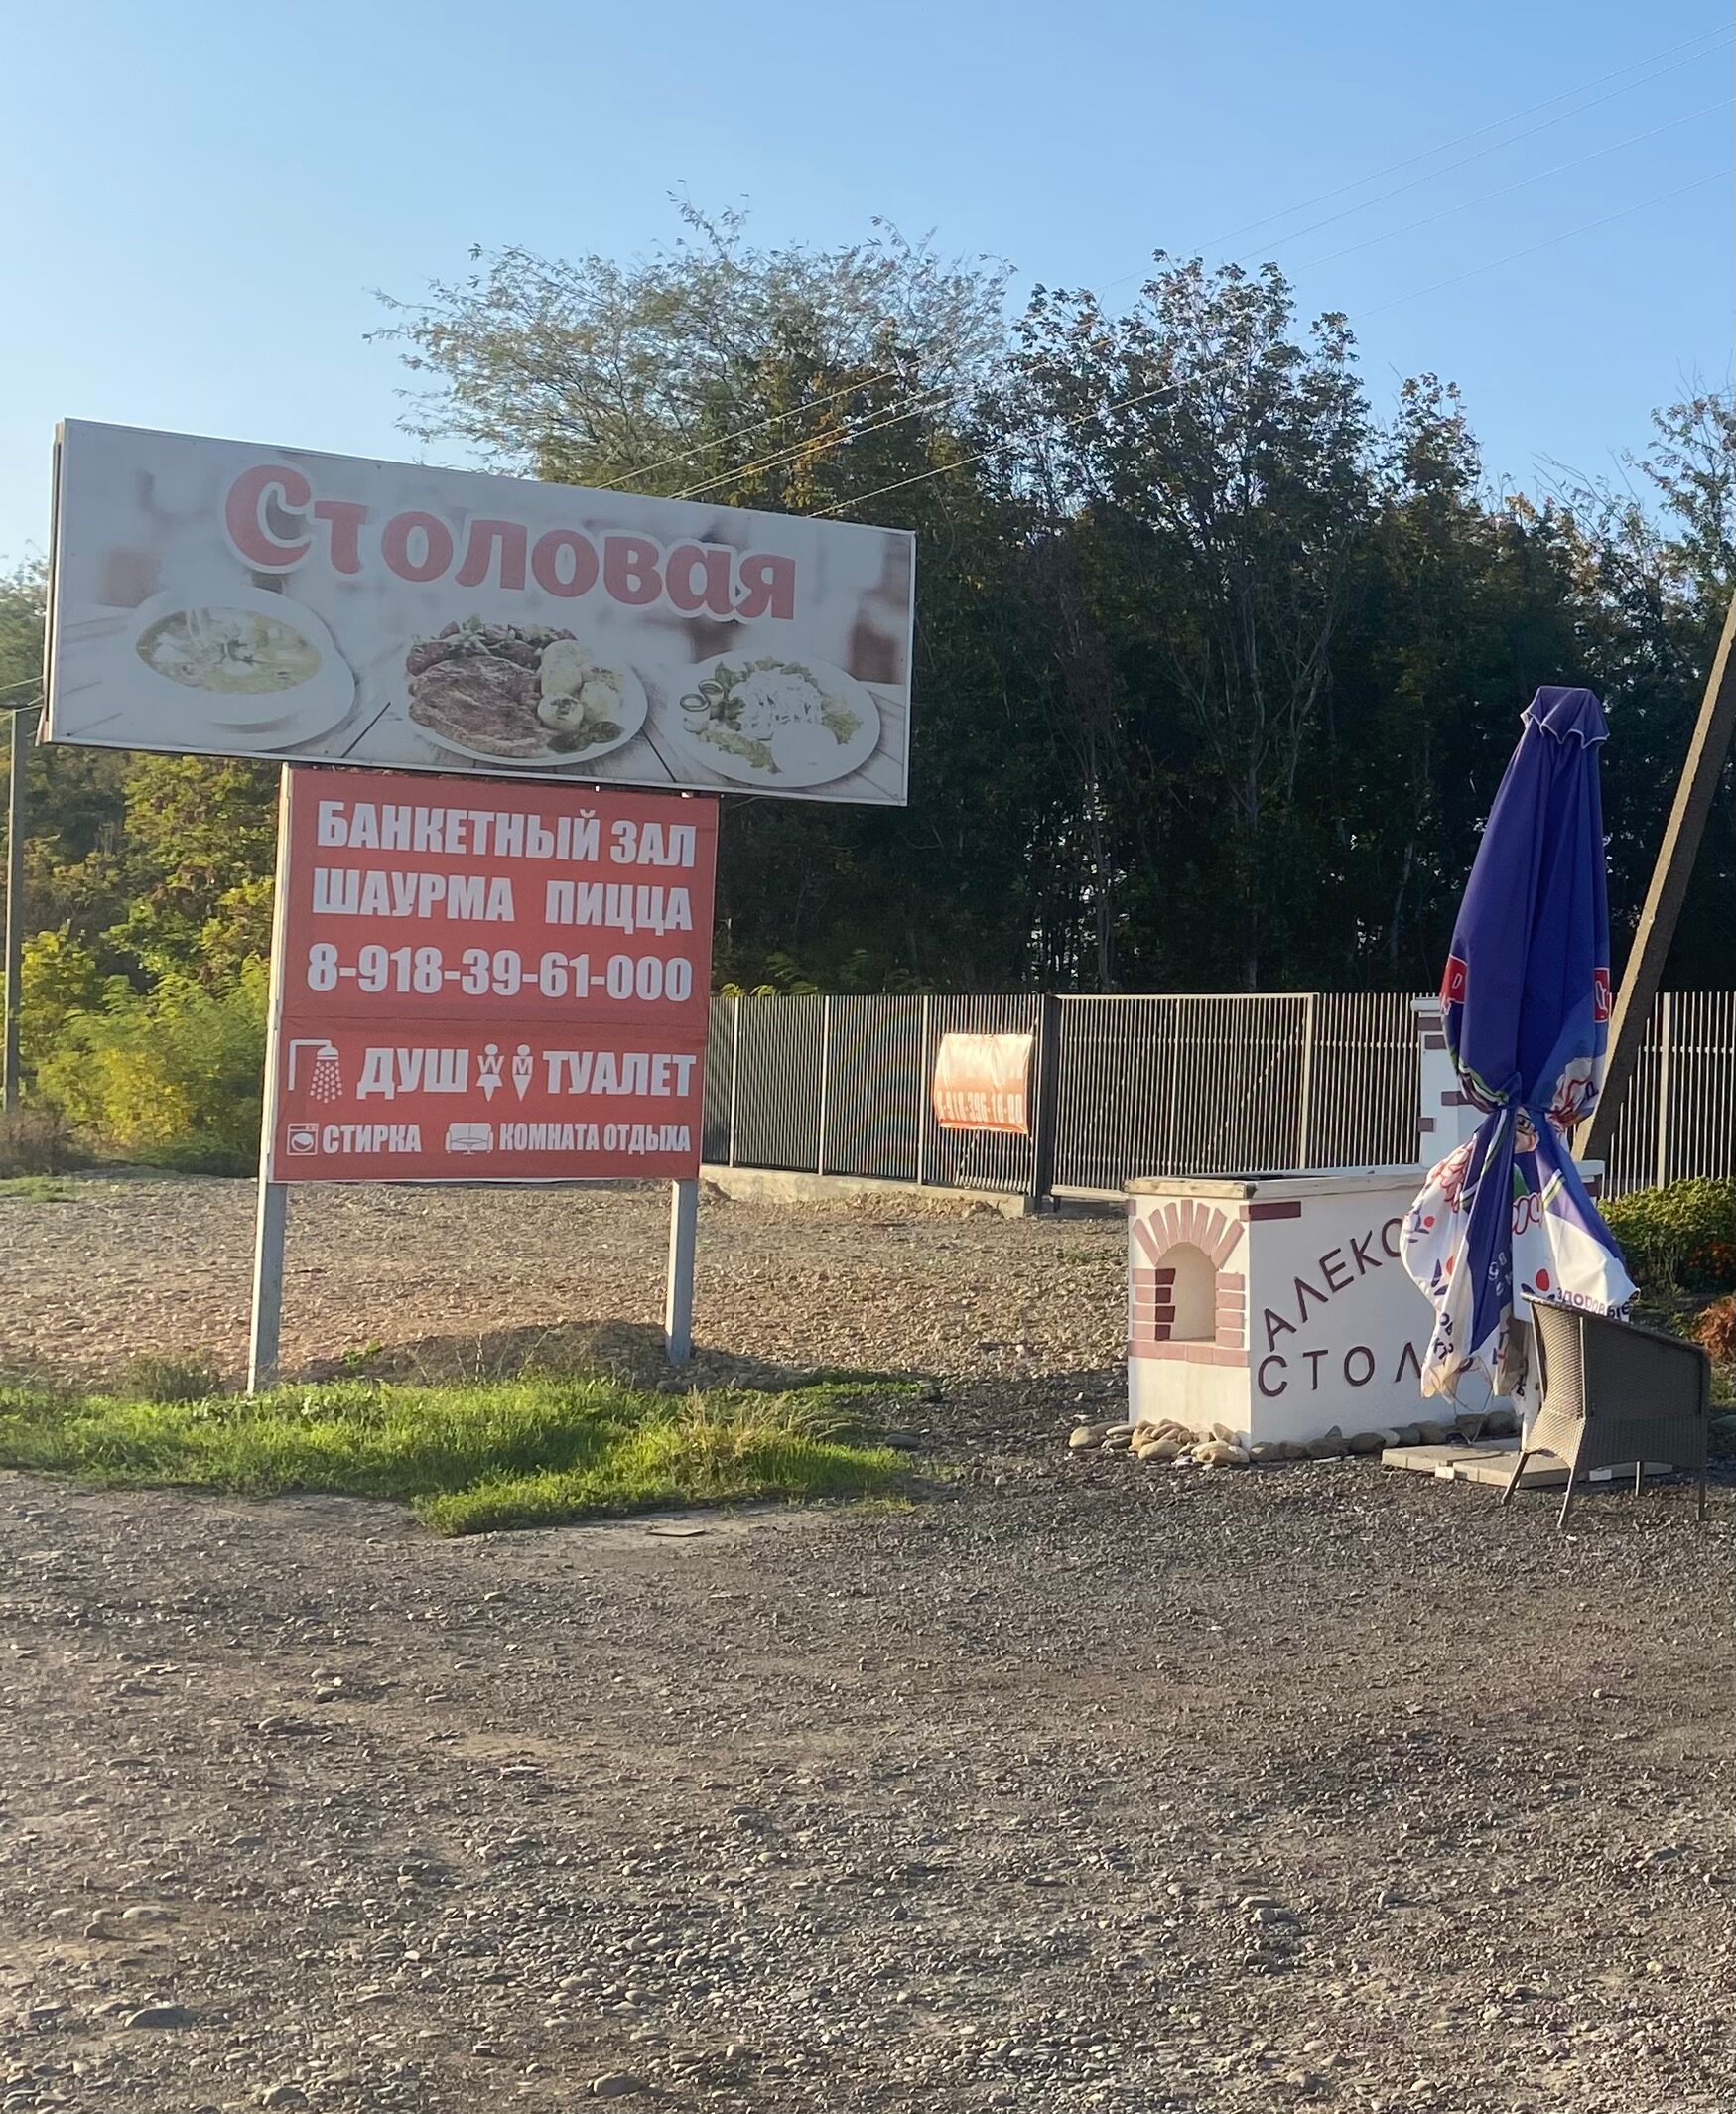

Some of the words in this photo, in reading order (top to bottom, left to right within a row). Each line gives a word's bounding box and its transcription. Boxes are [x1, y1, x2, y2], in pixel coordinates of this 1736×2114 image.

[224, 463, 796, 621] Столовая
[317, 800, 601, 862] БАНКЕТНЫЙ
[609, 819, 696, 868] ЗАЛ
[312, 867, 515, 922] ШАУРМА
[544, 879, 694, 937] ПИЦЦА
[306, 942, 693, 1001] 8-918-39-61-000
[355, 1047, 469, 1101] ДУШ
[542, 1050, 697, 1098] ТУАЛЕТ
[322, 1123, 422, 1154] СТИРКА
[498, 1123, 600, 1152] КОМНАТА
[603, 1123, 692, 1156] ОТДЫХА
[1257, 1342, 1474, 1397] СТОЛ
